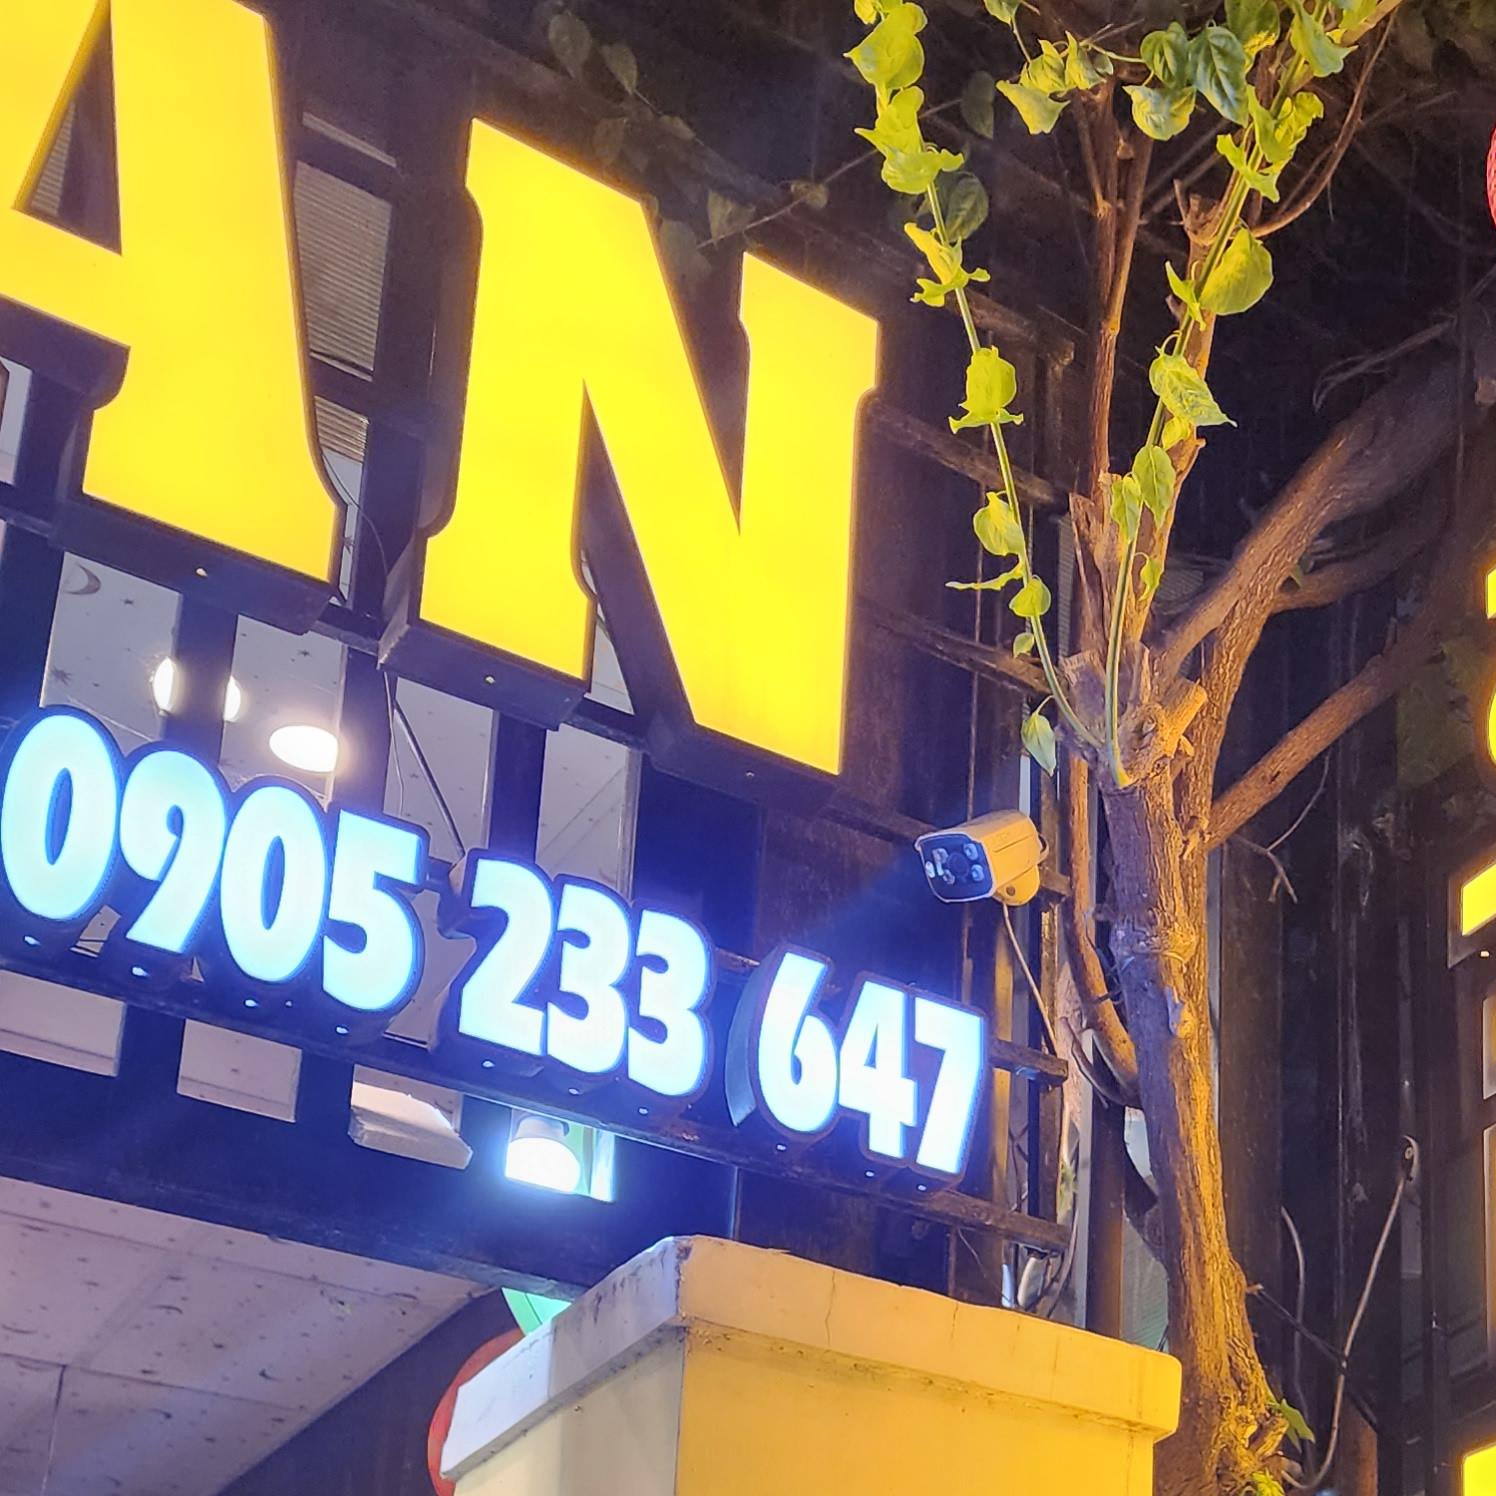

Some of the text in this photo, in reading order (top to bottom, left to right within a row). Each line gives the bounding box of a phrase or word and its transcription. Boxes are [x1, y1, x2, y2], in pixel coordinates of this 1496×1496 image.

[1, 714, 985, 1174] 0905 233 647
